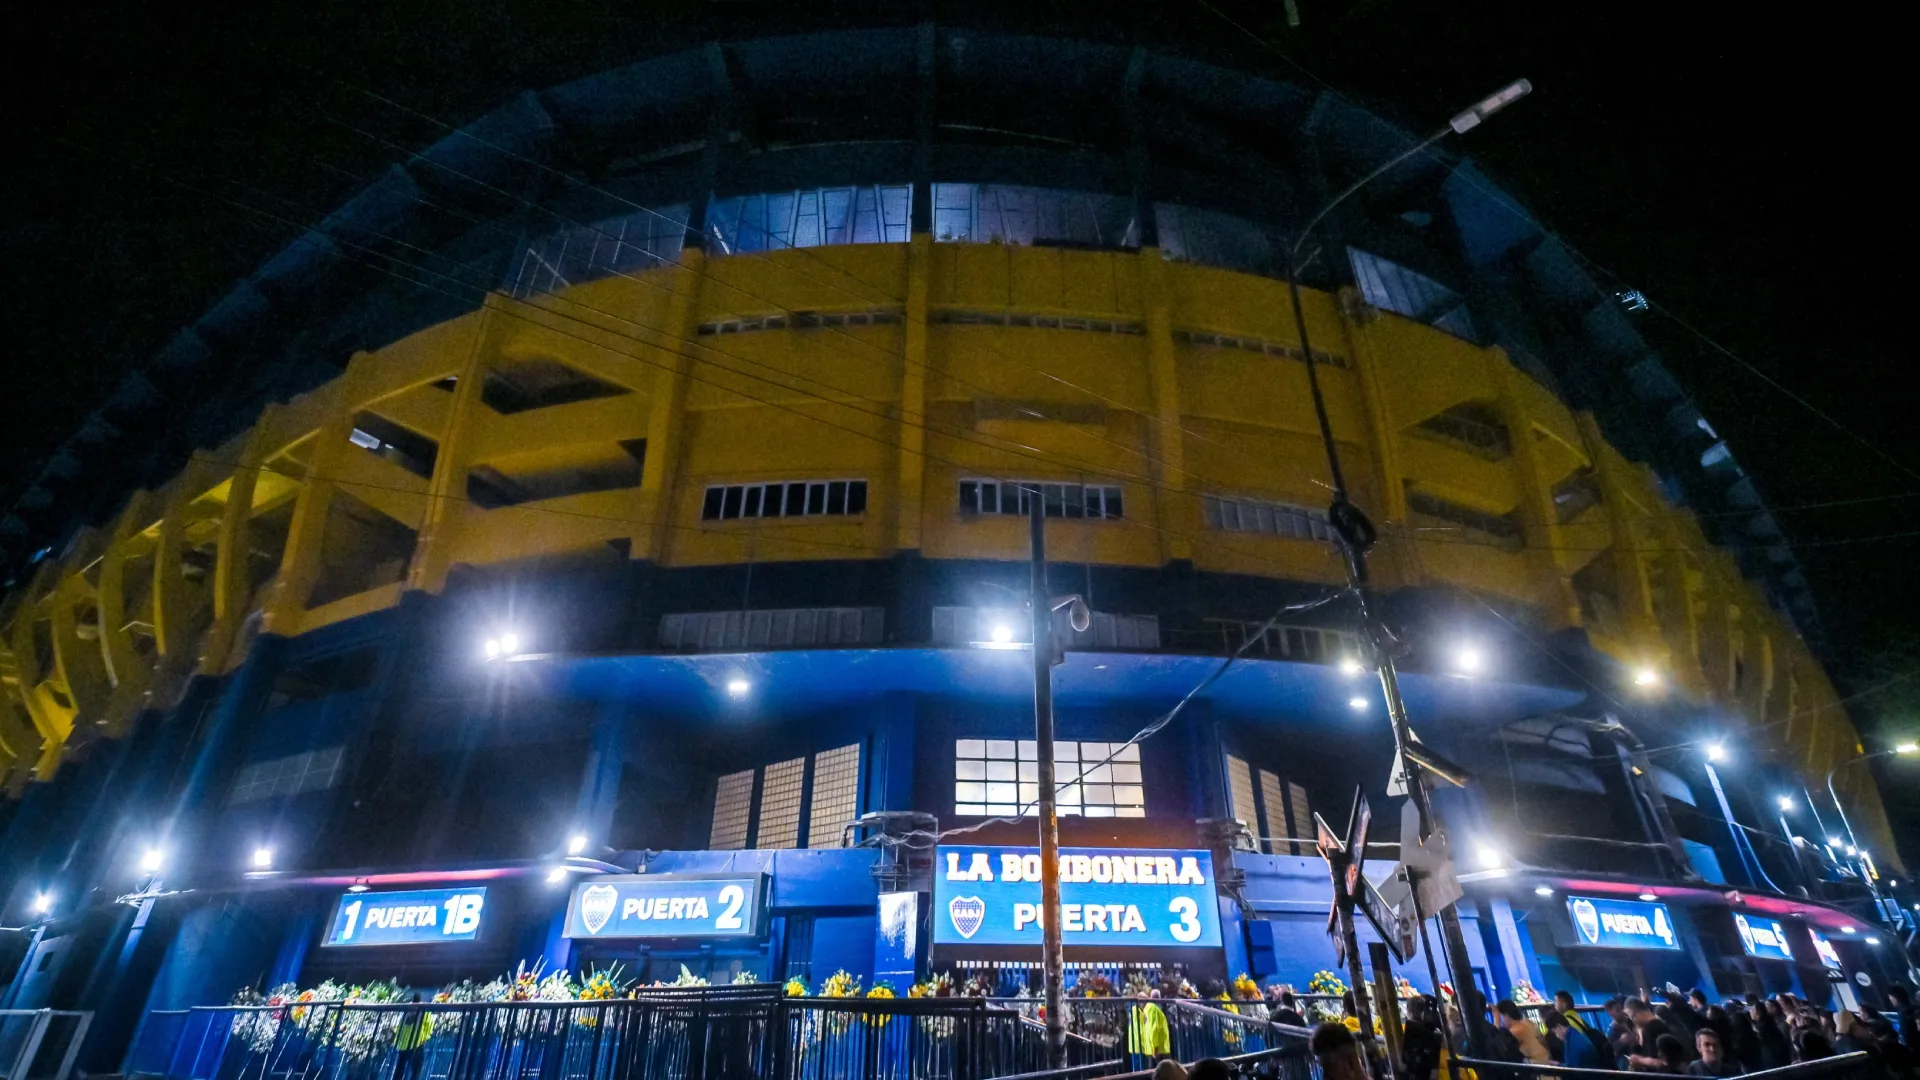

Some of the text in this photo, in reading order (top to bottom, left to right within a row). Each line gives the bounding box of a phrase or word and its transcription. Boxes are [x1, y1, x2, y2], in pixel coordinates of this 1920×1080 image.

[946, 853, 994, 882] LA
[342, 894, 484, 940] 1 PUERTA 1B
[622, 897, 709, 920] PUERTA
[715, 884, 745, 929] 2
[1169, 896, 1202, 942] 3
[1600, 908, 1673, 945] PUERTA 4
